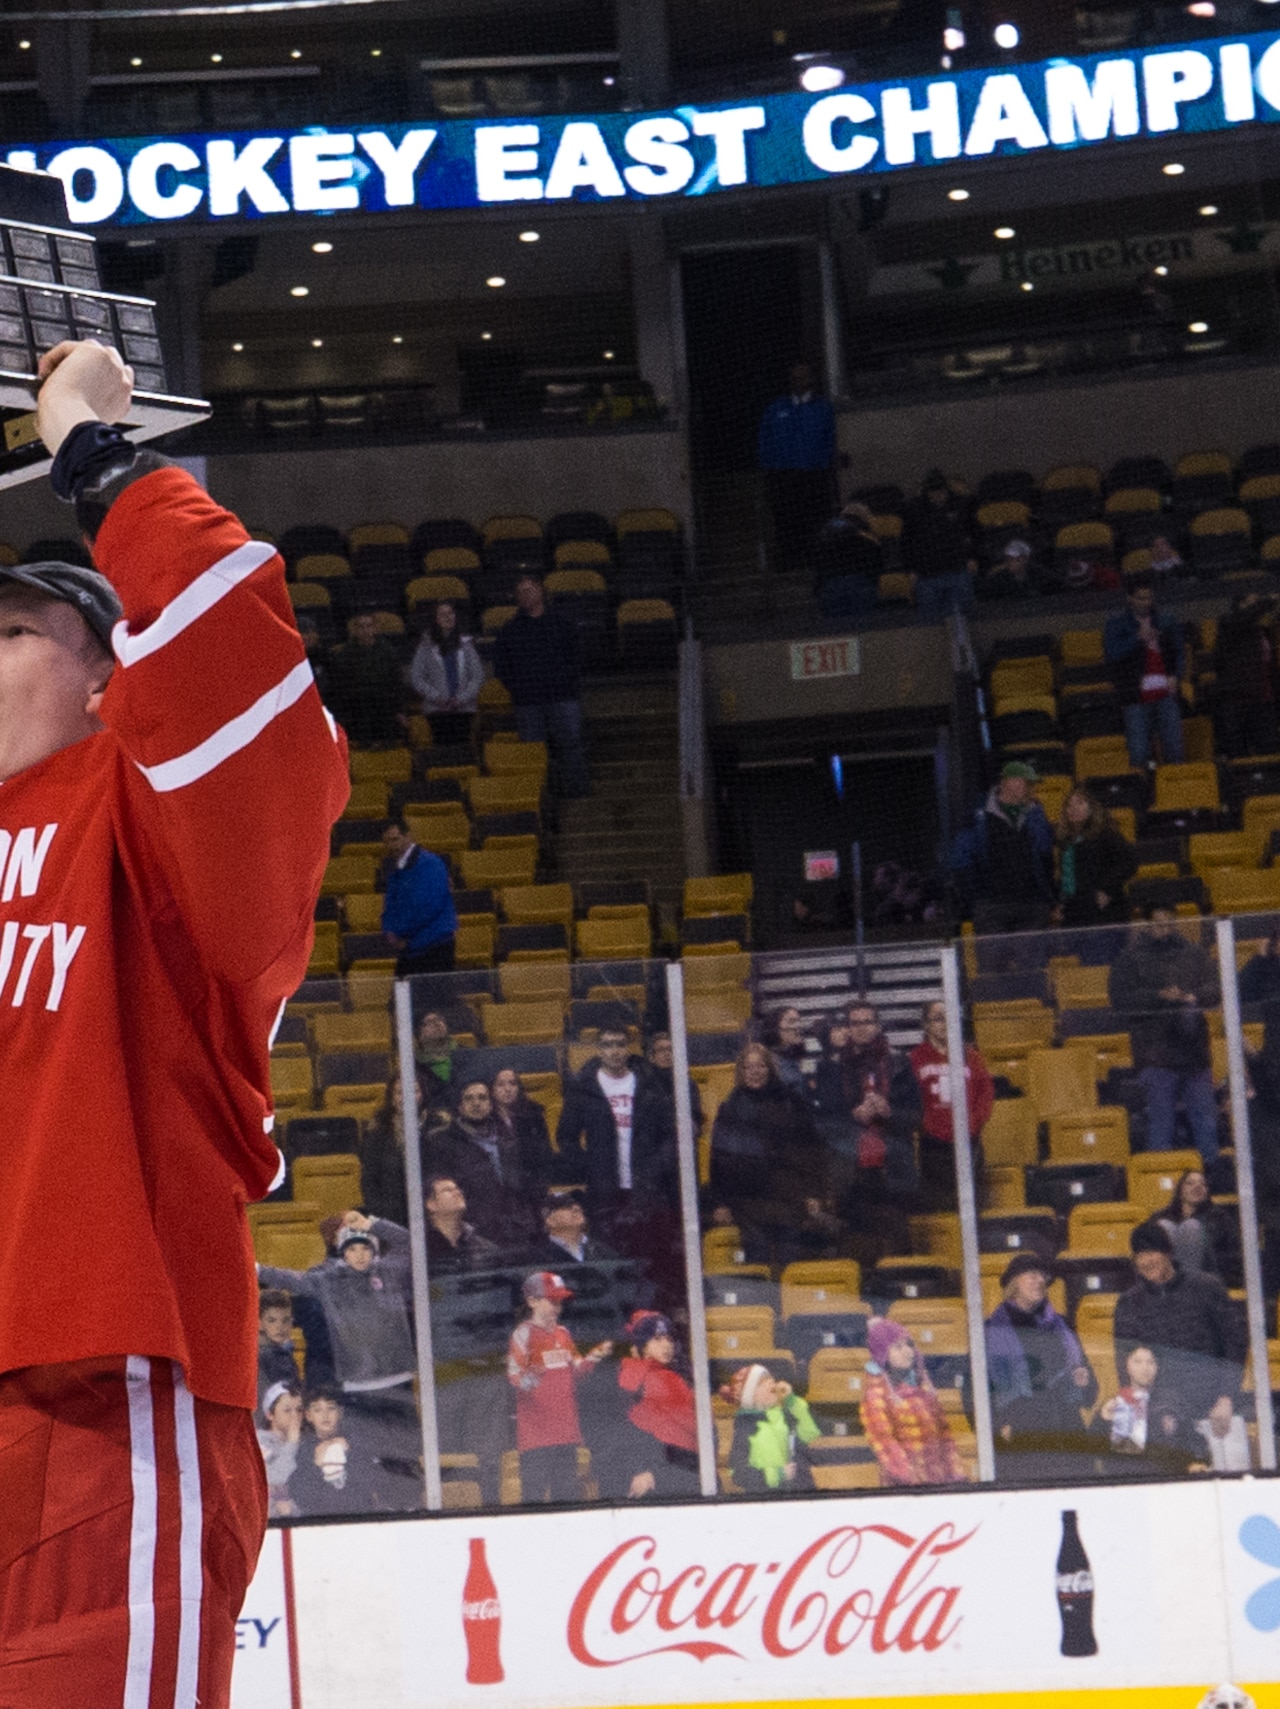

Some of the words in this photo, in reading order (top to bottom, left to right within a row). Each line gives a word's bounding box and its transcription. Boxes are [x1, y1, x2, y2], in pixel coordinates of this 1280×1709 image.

[474, 105, 766, 202] EAST
[1001, 235, 1194, 282] Heineken
[803, 641, 848, 675] EXIT
[566, 1520, 984, 1669] Coca-Cola
